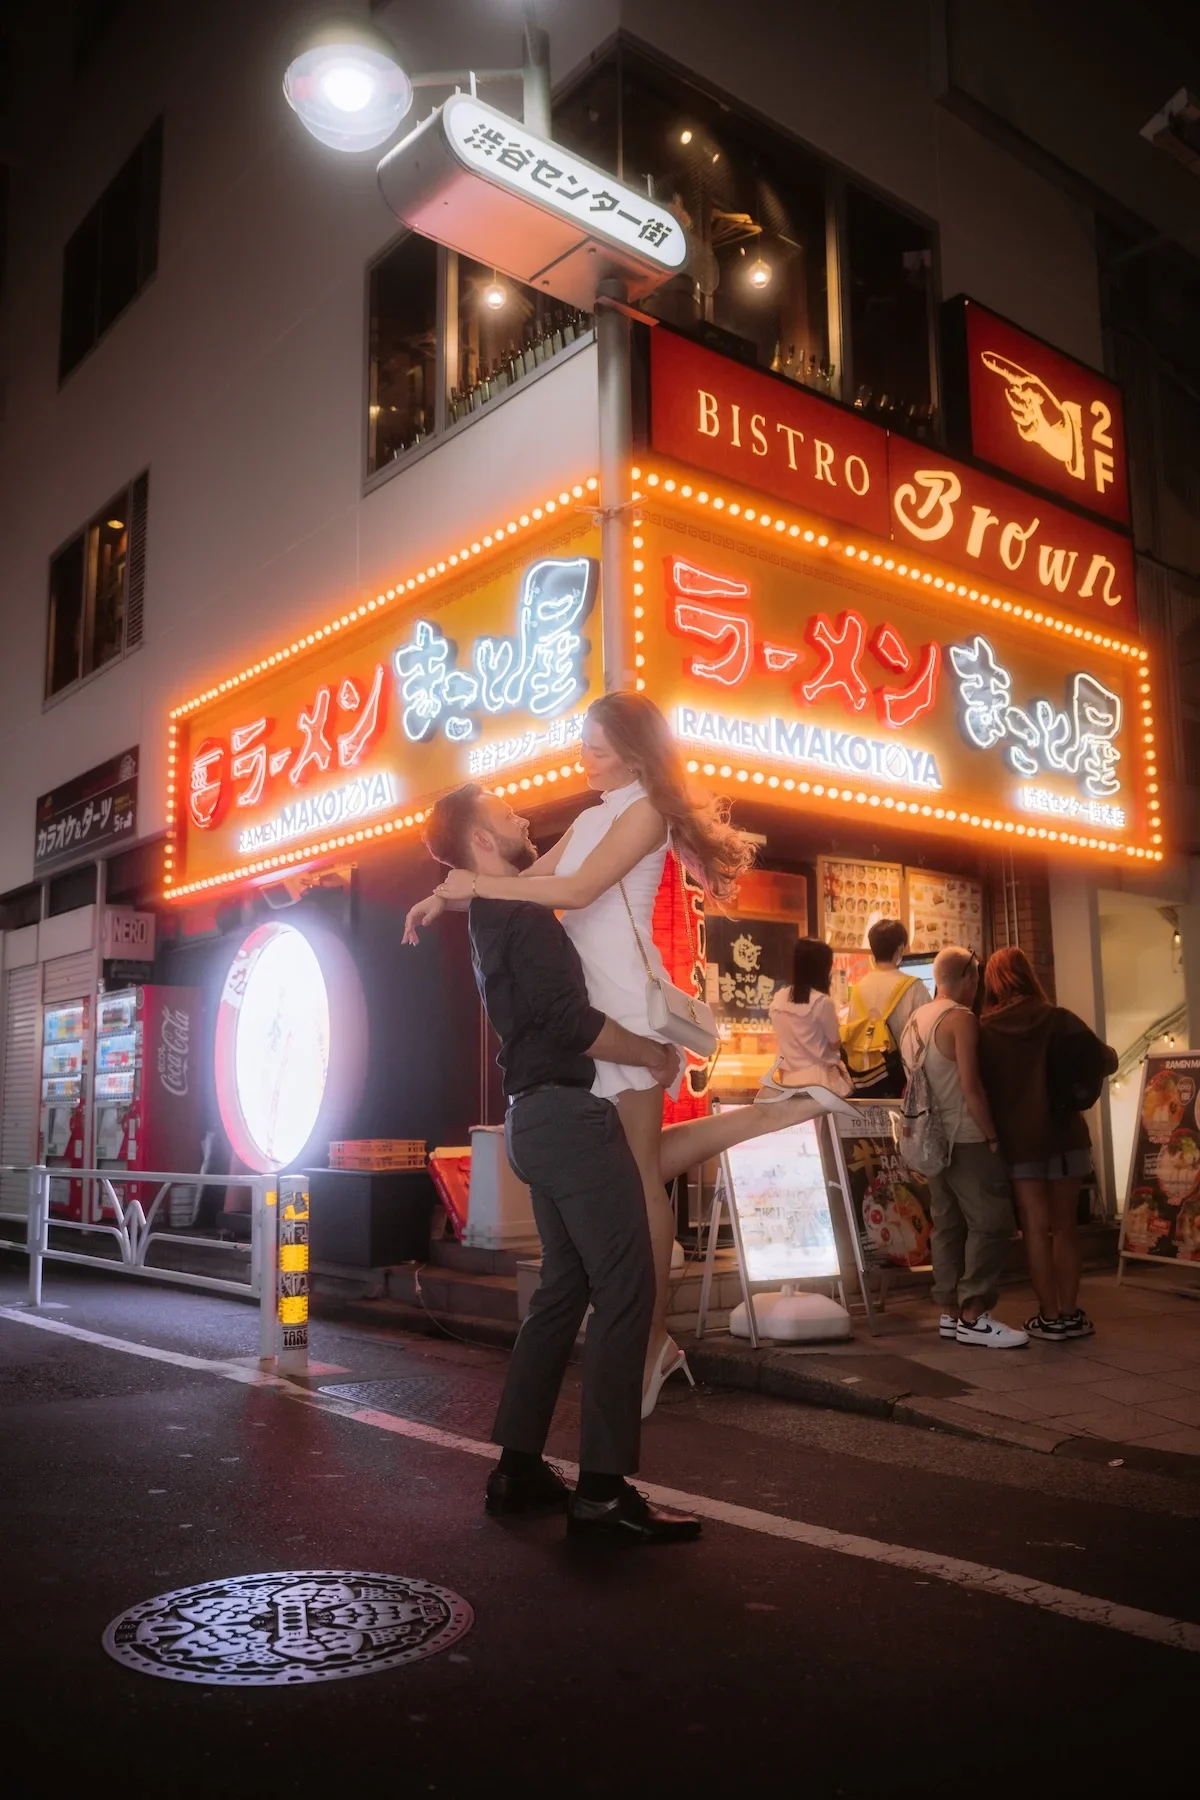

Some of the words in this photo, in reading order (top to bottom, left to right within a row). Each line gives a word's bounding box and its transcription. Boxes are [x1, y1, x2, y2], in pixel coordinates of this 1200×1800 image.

[464, 124, 673, 248] 渋谷センター街
[698, 389, 870, 496] BISTRO
[894, 470, 1121, 606] Brown
[670, 558, 938, 728] ラーメン
[230, 662, 387, 806] ラーメン
[678, 706, 770, 751] RAMEN
[770, 716, 942, 789] MAKOTOYA
[239, 820, 281, 852] RAMEN
[280, 772, 394, 836] MAKOTOYA
[113, 917, 147, 943] NERO
[161, 1004, 190, 1097] Coca-Cola
[1165, 1060, 1191, 1069] RAMEN
[851, 1119, 862, 1127] TO
